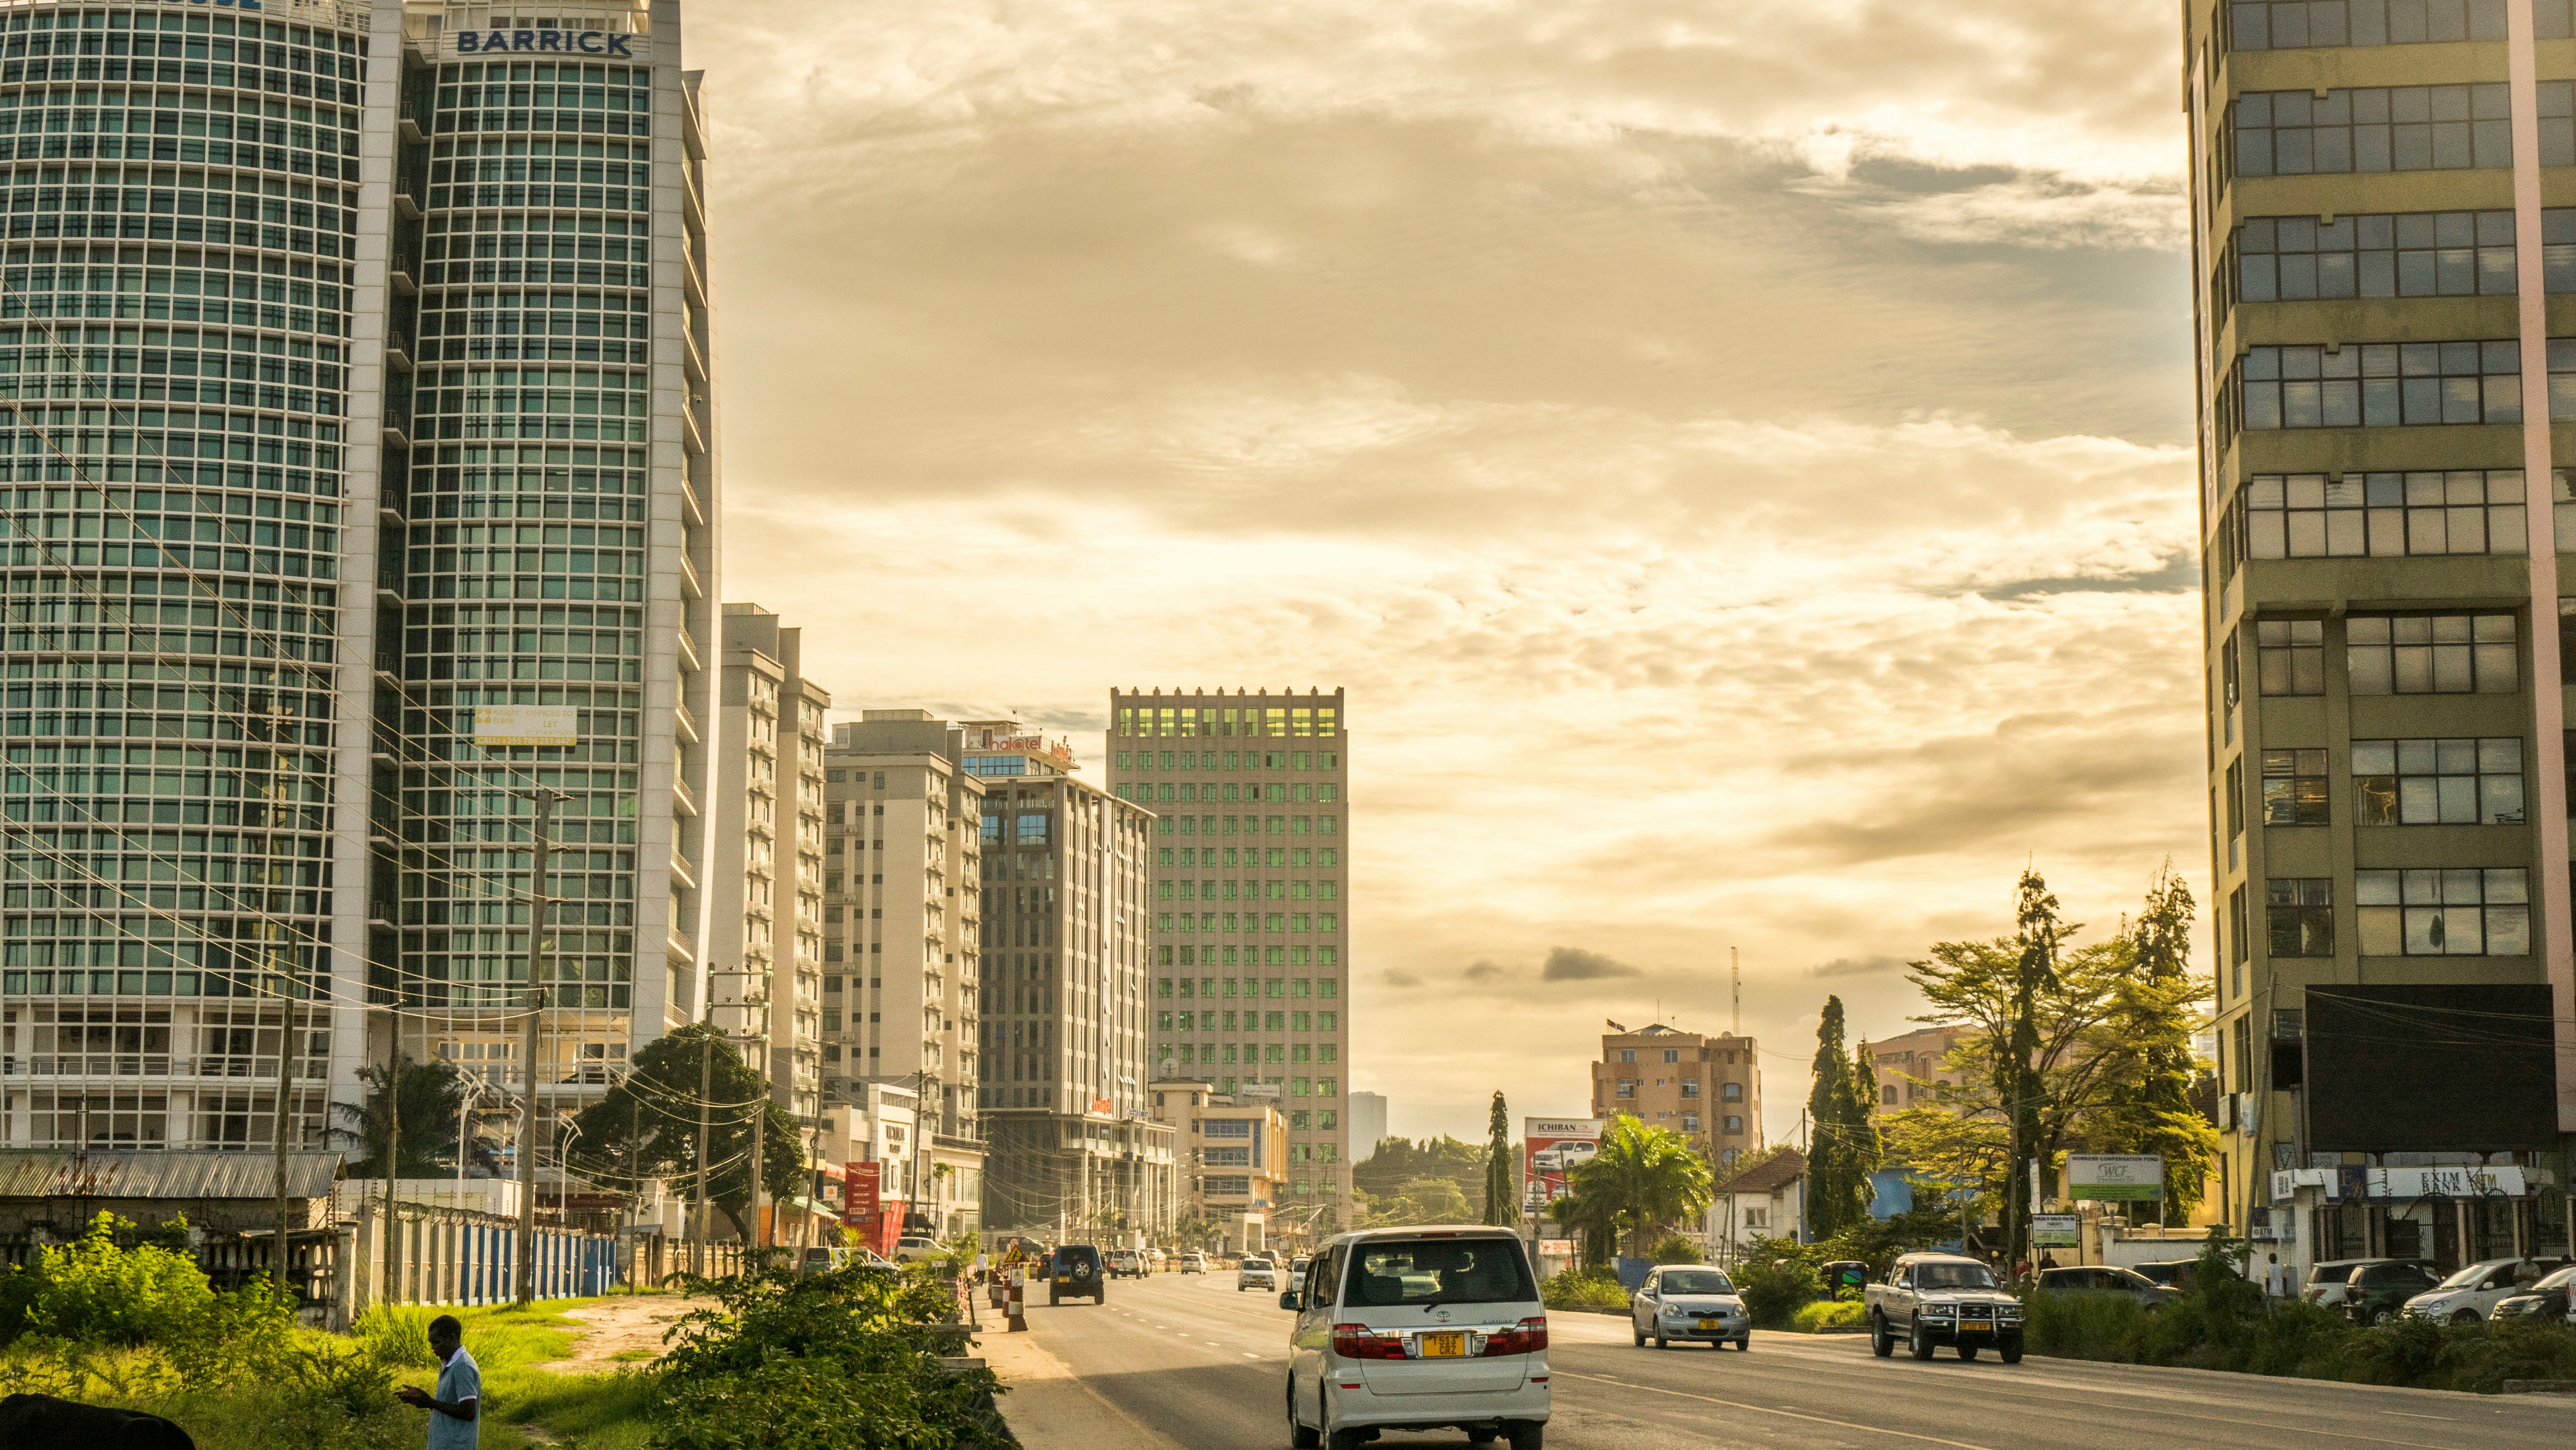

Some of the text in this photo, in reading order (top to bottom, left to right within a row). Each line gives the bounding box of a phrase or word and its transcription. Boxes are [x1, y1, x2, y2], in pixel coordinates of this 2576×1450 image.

[457, 30, 632, 56] BARRICK
[493, 709, 519, 717] Knight
[990, 736, 1041, 751] halotel
[2104, 1165, 2128, 1176] WCF
[2421, 1172, 2460, 1182] EXIM
[2422, 1182, 2461, 1192] BANK
[2259, 1227, 2272, 1235] ATM
[1440, 1345, 1457, 1355] CRZ
